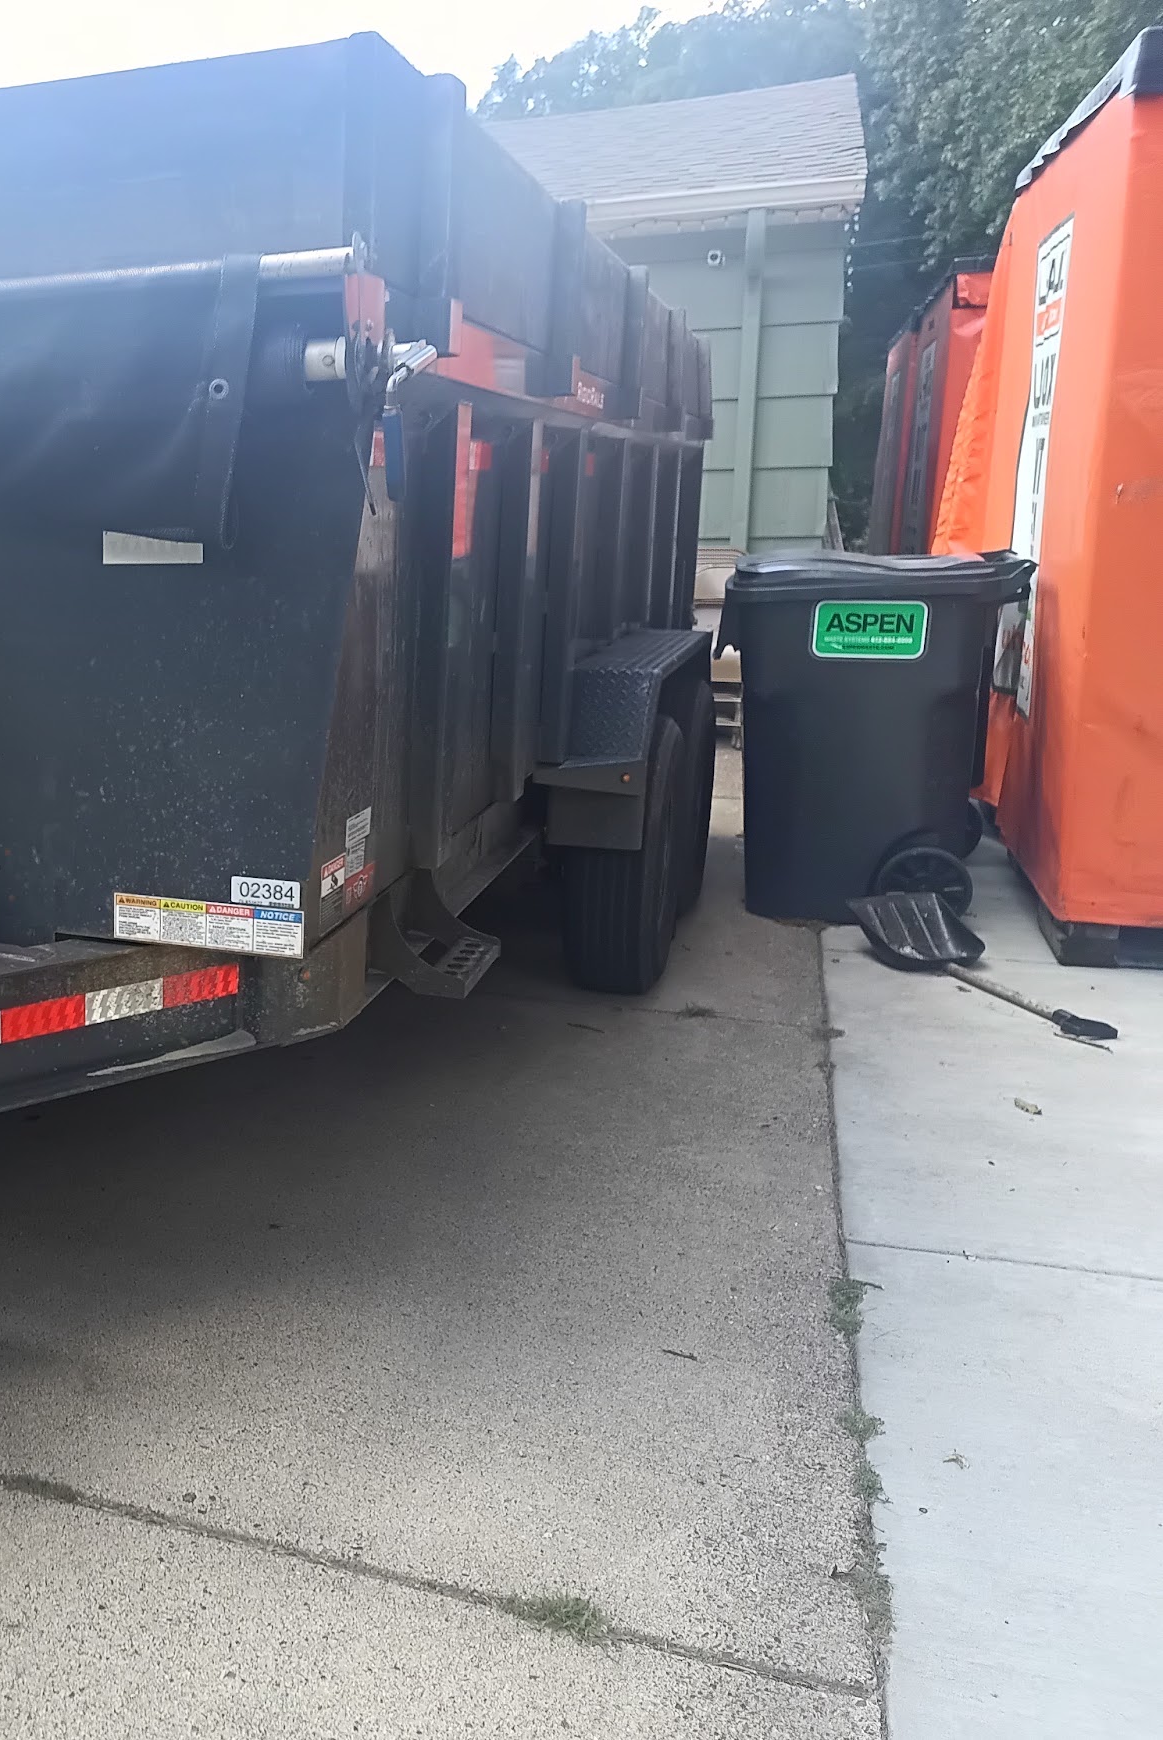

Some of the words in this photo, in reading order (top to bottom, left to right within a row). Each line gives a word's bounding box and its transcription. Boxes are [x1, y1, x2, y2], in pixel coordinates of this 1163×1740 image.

[825, 612, 915, 634] ASPEN
[239, 881, 295, 902] 02384
[125, 898, 158, 907] WARNING
[170, 902, 204, 911] CAUTION
[216, 906, 251, 916] DANGER
[260, 911, 295, 921] NOTICE
